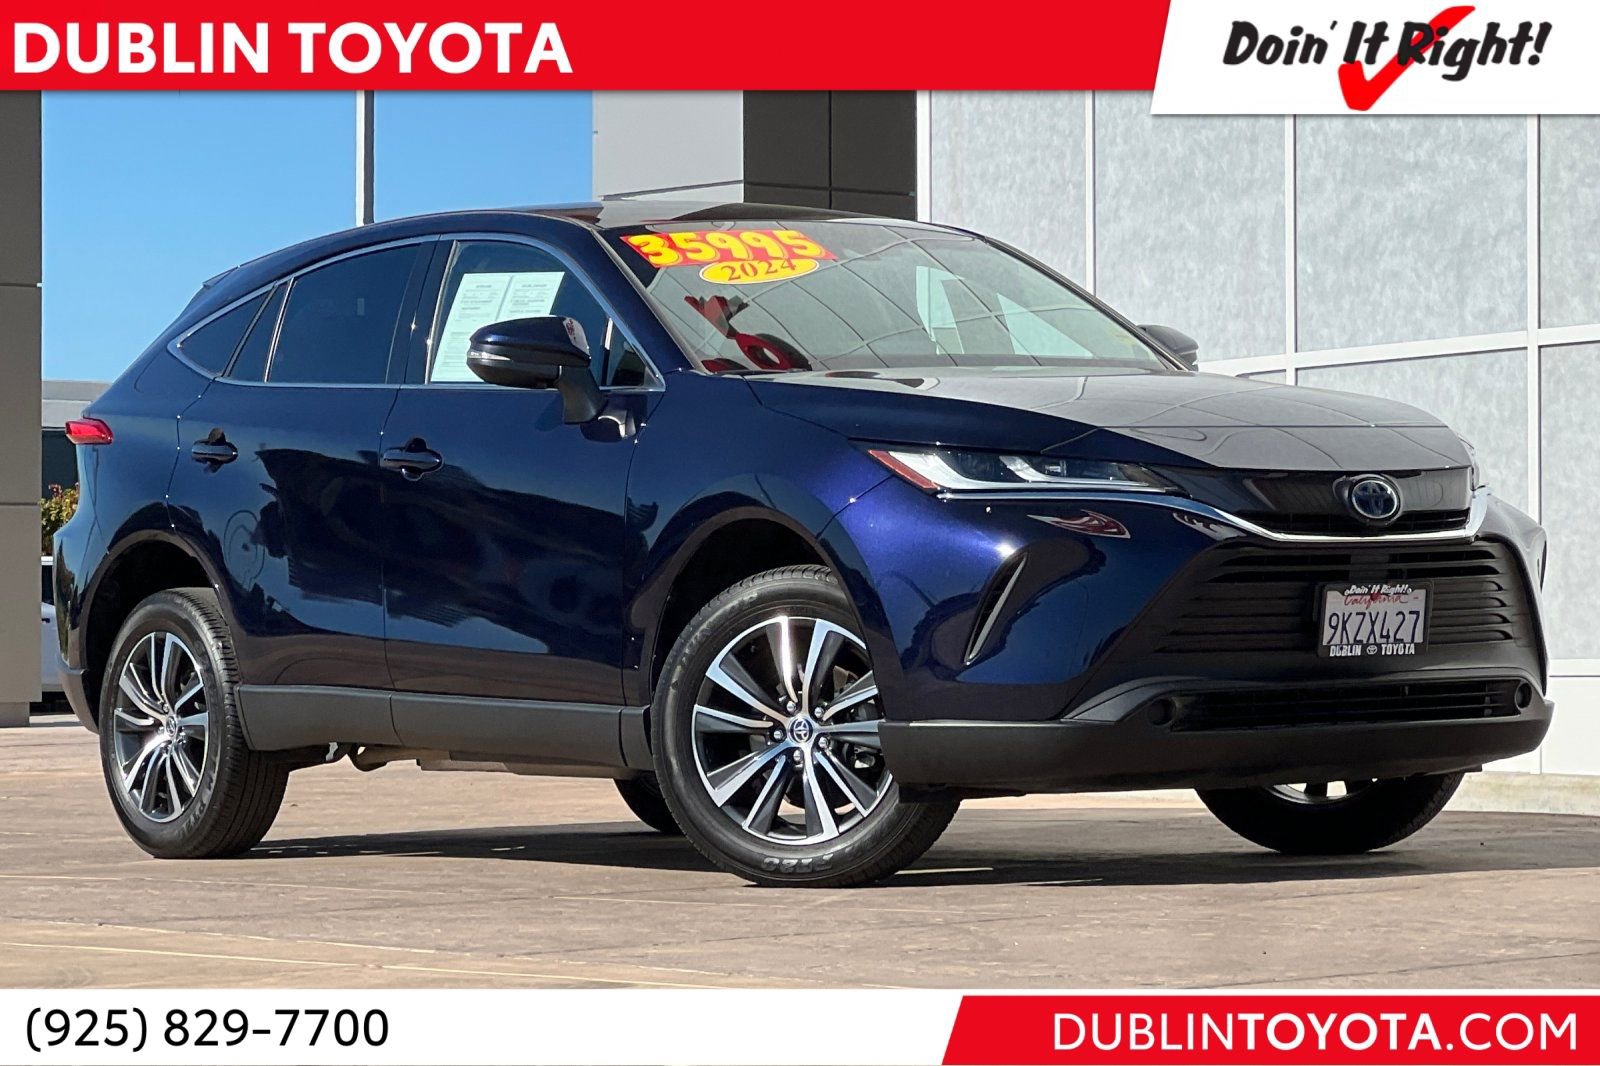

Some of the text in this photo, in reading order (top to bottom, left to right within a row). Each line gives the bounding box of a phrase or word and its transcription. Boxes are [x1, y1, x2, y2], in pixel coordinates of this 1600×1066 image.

[629, 230, 824, 266] 35995
[721, 258, 797, 282] 2024
[1327, 611, 1420, 645] 9KZX427
[1330, 644, 1415, 657] DUBLIN TOYOTA
